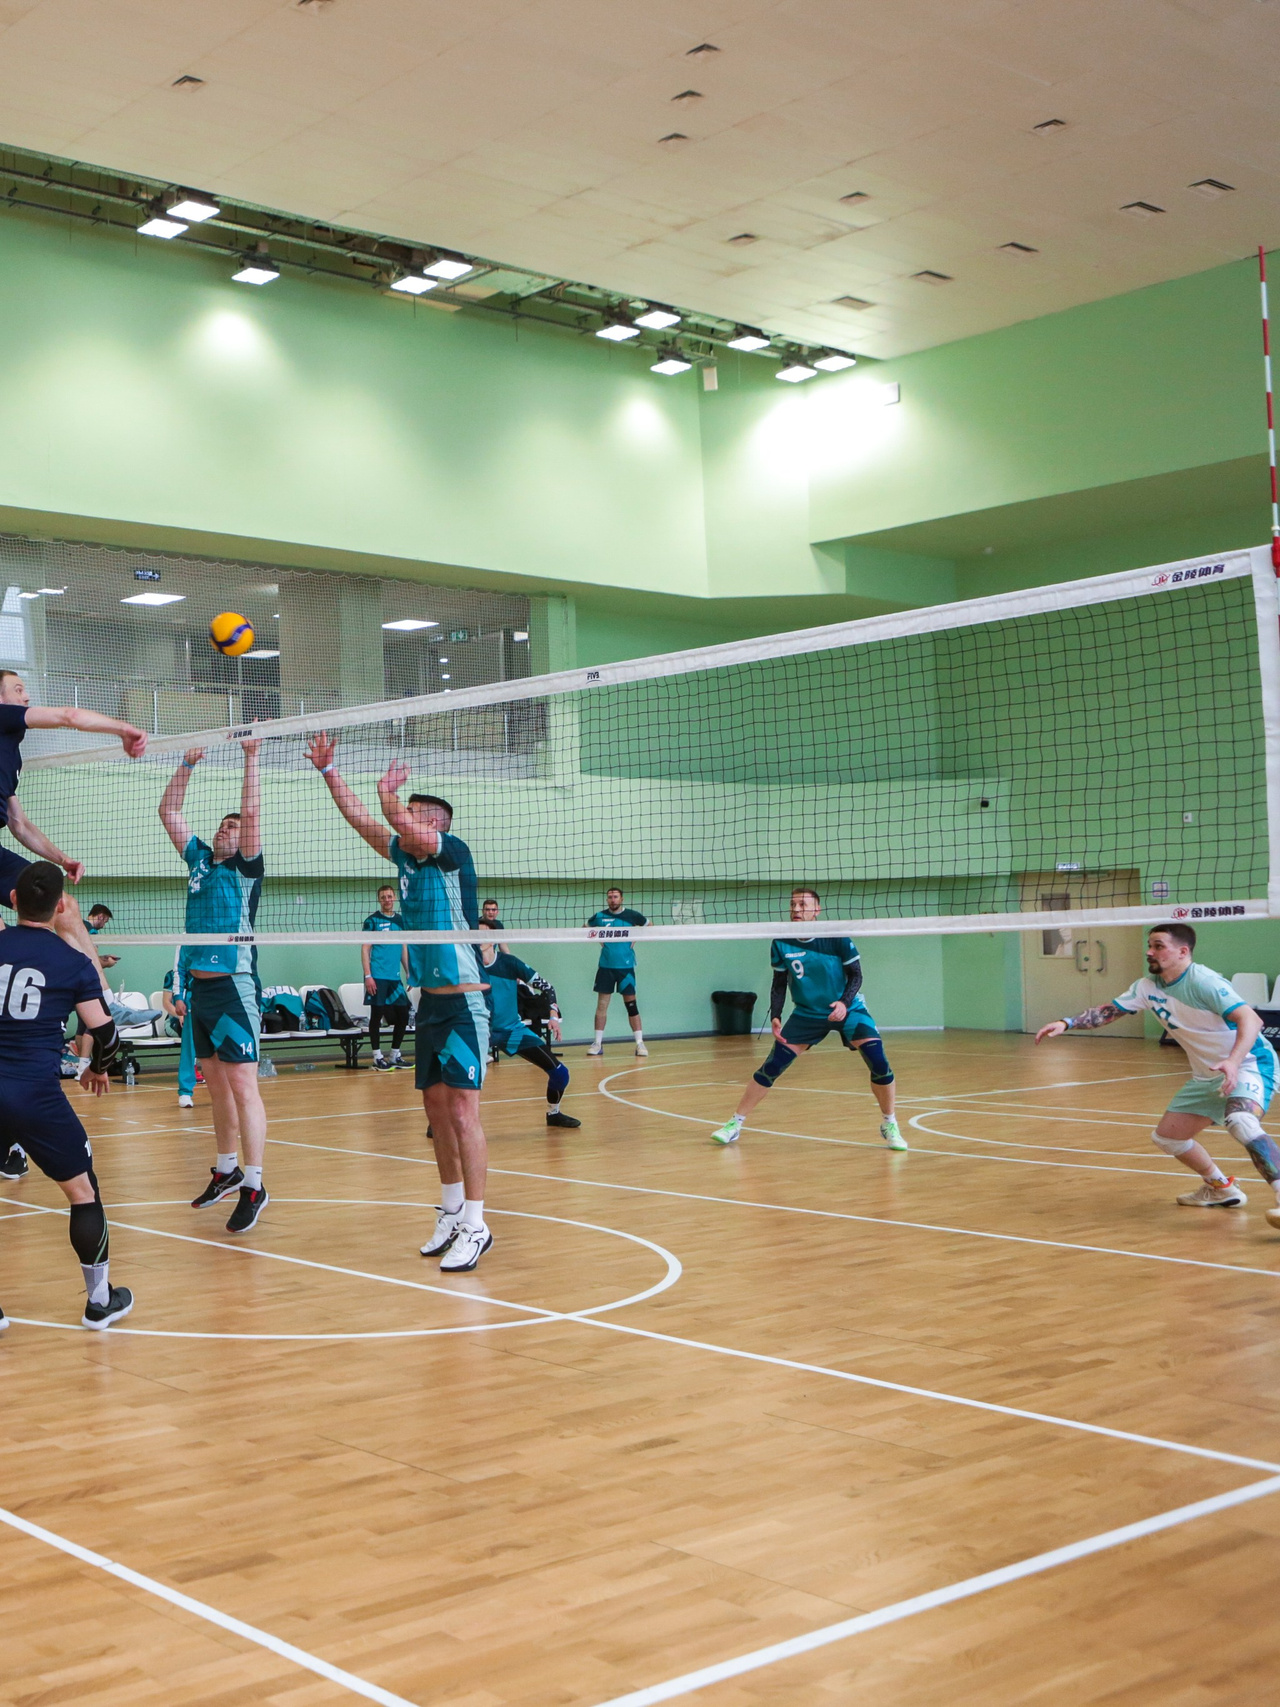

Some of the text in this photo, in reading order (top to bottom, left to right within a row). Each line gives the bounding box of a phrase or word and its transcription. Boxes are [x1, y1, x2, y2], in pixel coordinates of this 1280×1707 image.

[586, 671, 600, 681] FIVB
[791, 959, 804, 979] 9
[240, 1042, 253, 1055] 14
[468, 1066, 475, 1080] 8
[1245, 1082, 1260, 1095] 12
